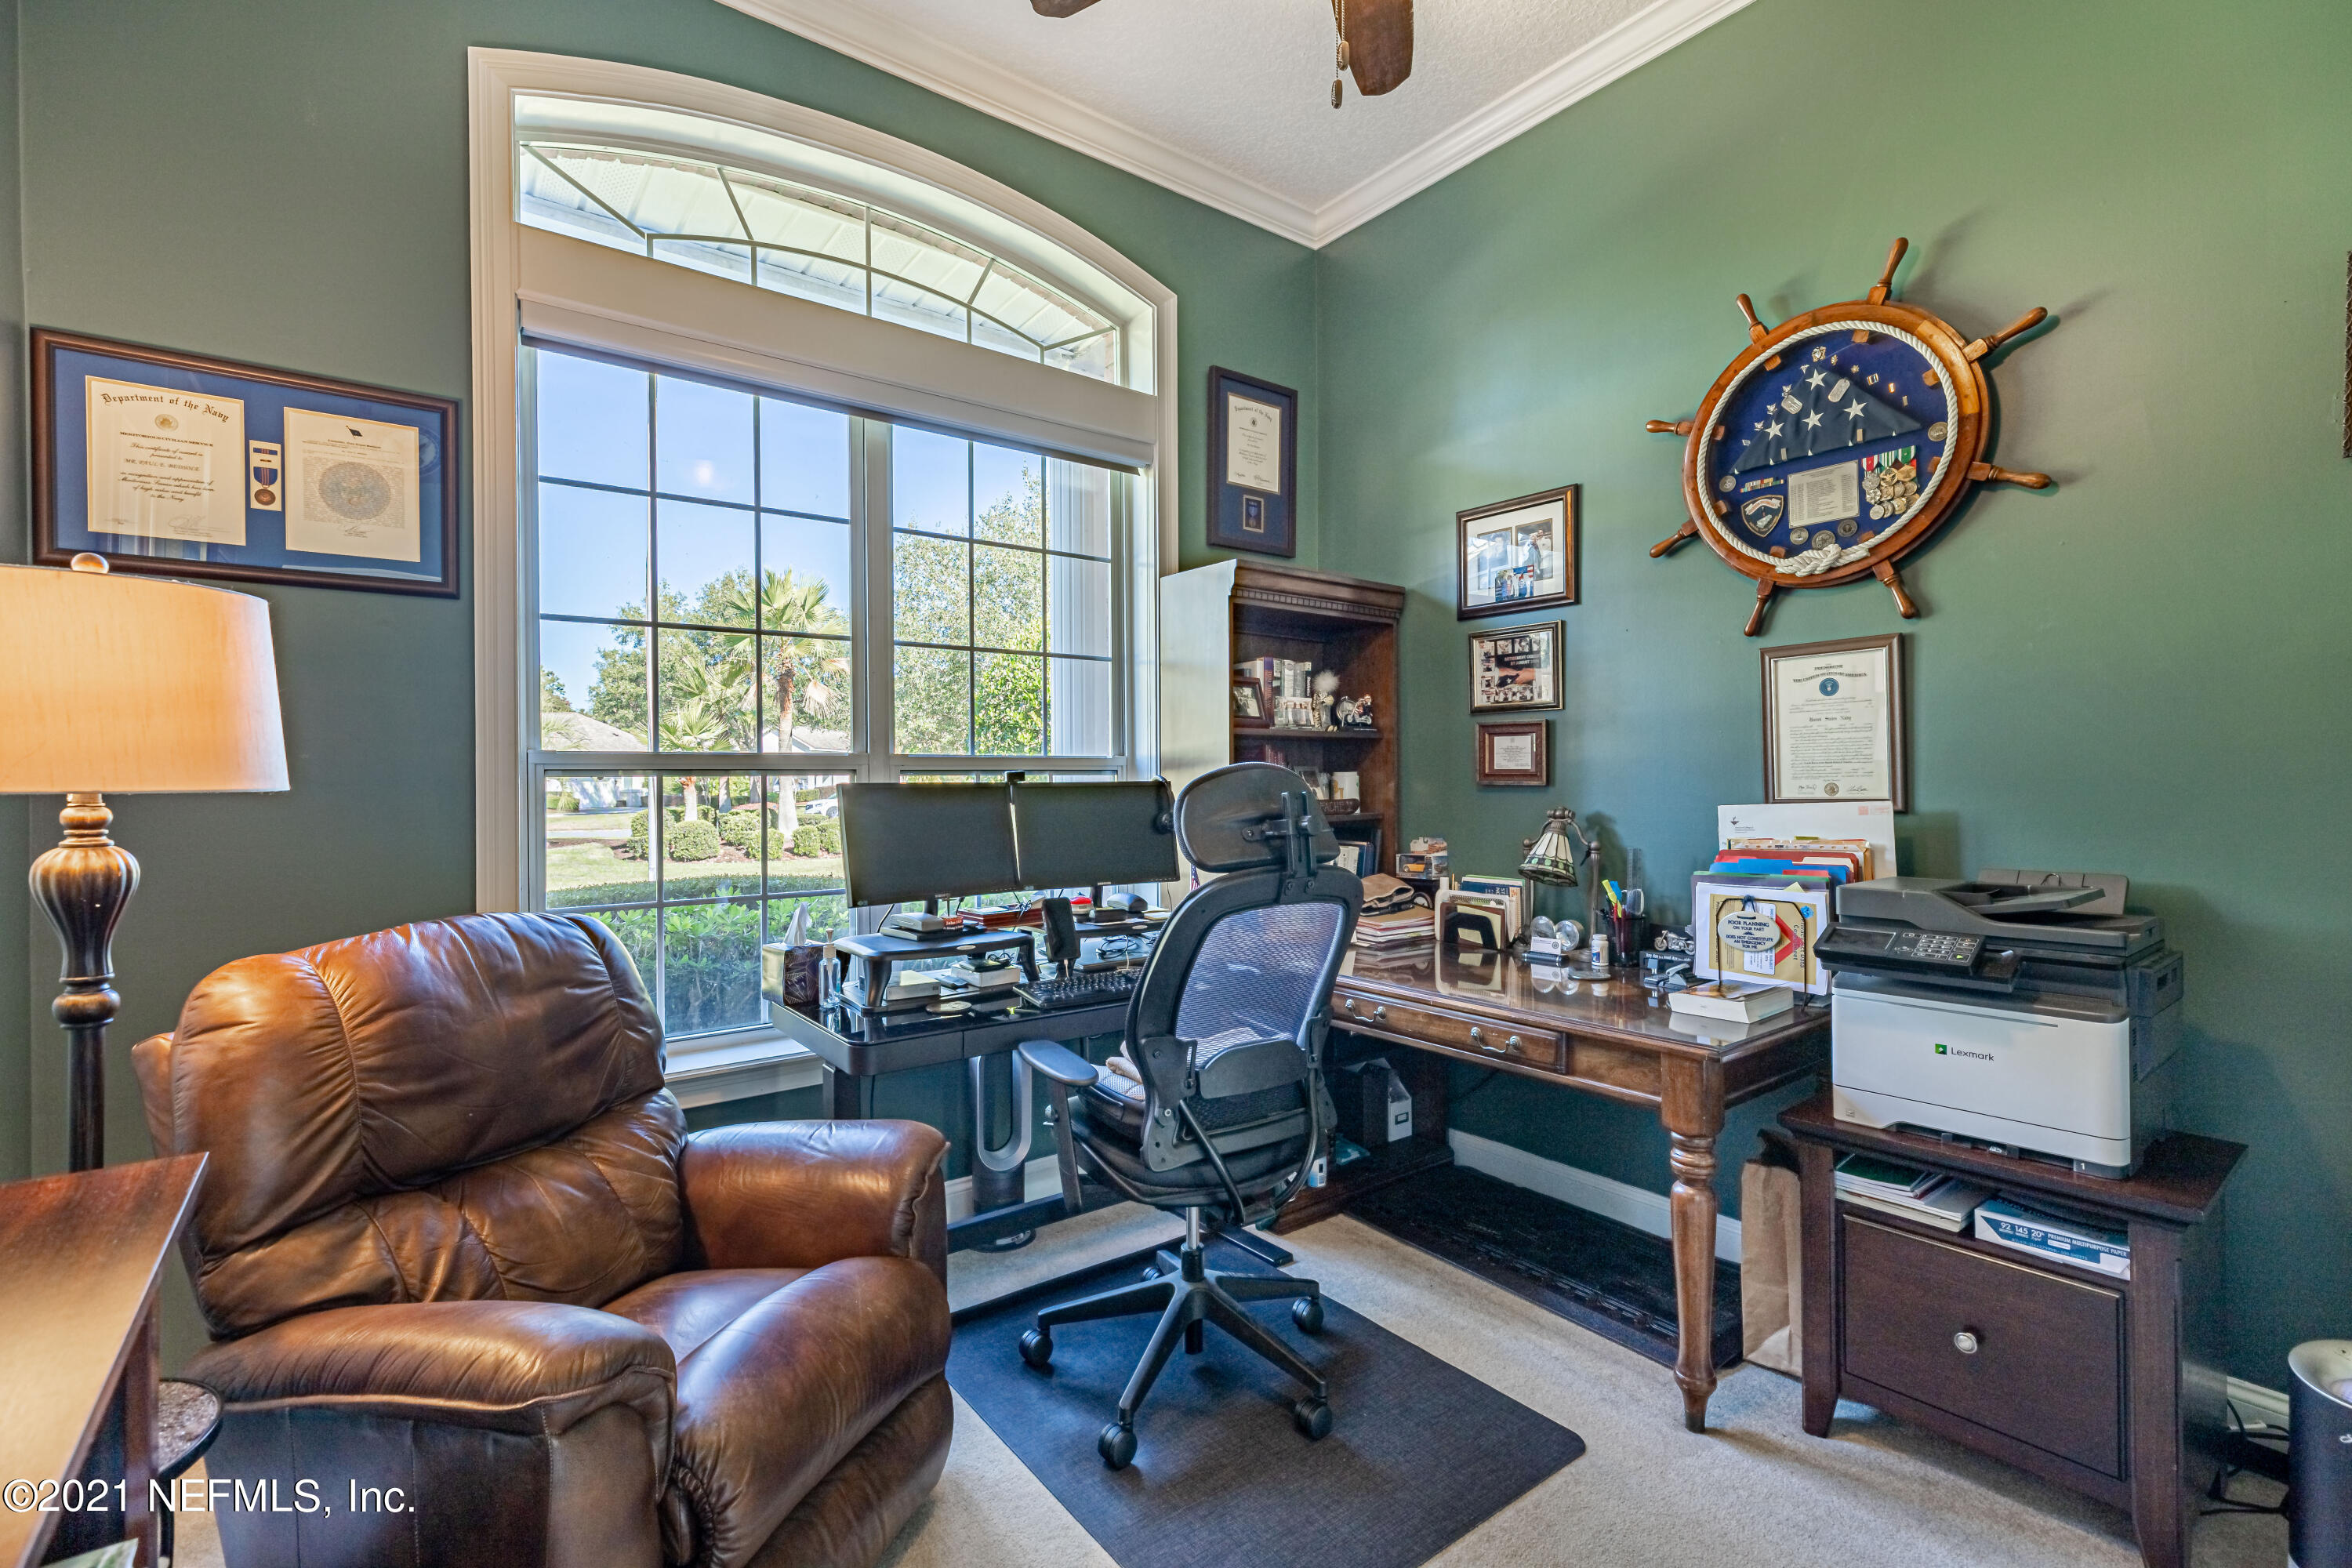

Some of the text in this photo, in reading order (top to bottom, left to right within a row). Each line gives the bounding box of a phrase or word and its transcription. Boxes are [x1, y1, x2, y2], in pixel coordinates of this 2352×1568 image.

[100, 393, 230, 423] Department of the Navy
[1951, 1047, 1994, 1062] Lexmark
[2001, 1221, 2011, 1231] 92
[2015, 1225, 2028, 1235] 145
[2048, 1232, 2127, 1257] PREMIUM MULTIPURPOSE PAPER
